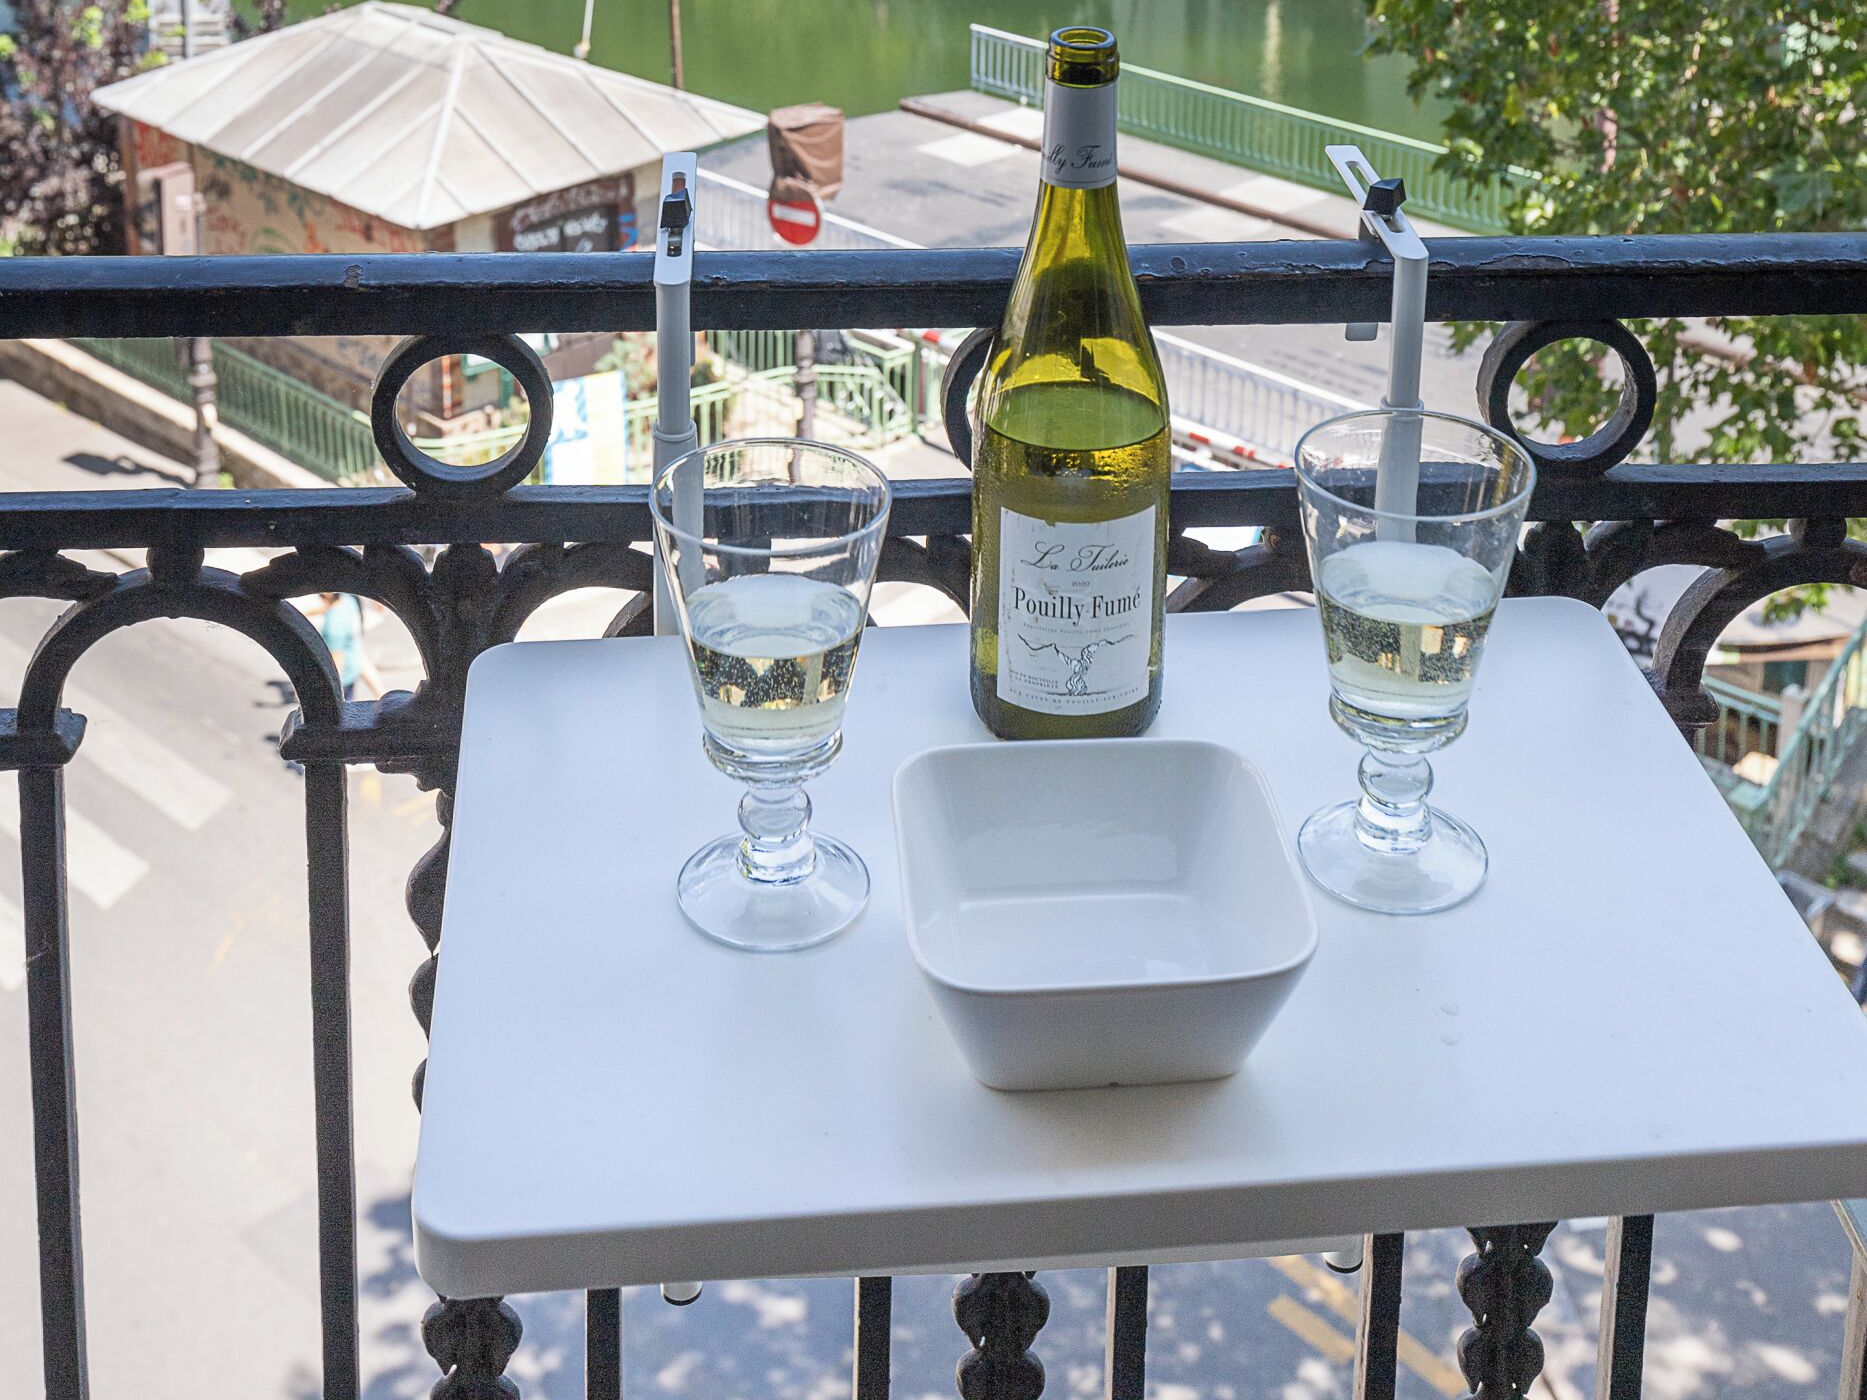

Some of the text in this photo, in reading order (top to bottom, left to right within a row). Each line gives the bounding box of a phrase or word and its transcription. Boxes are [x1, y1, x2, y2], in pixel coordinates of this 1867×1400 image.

[1020, 540, 1130, 573] La Tuilerie
[1010, 583, 1141, 627] Pouilly-Fumé
